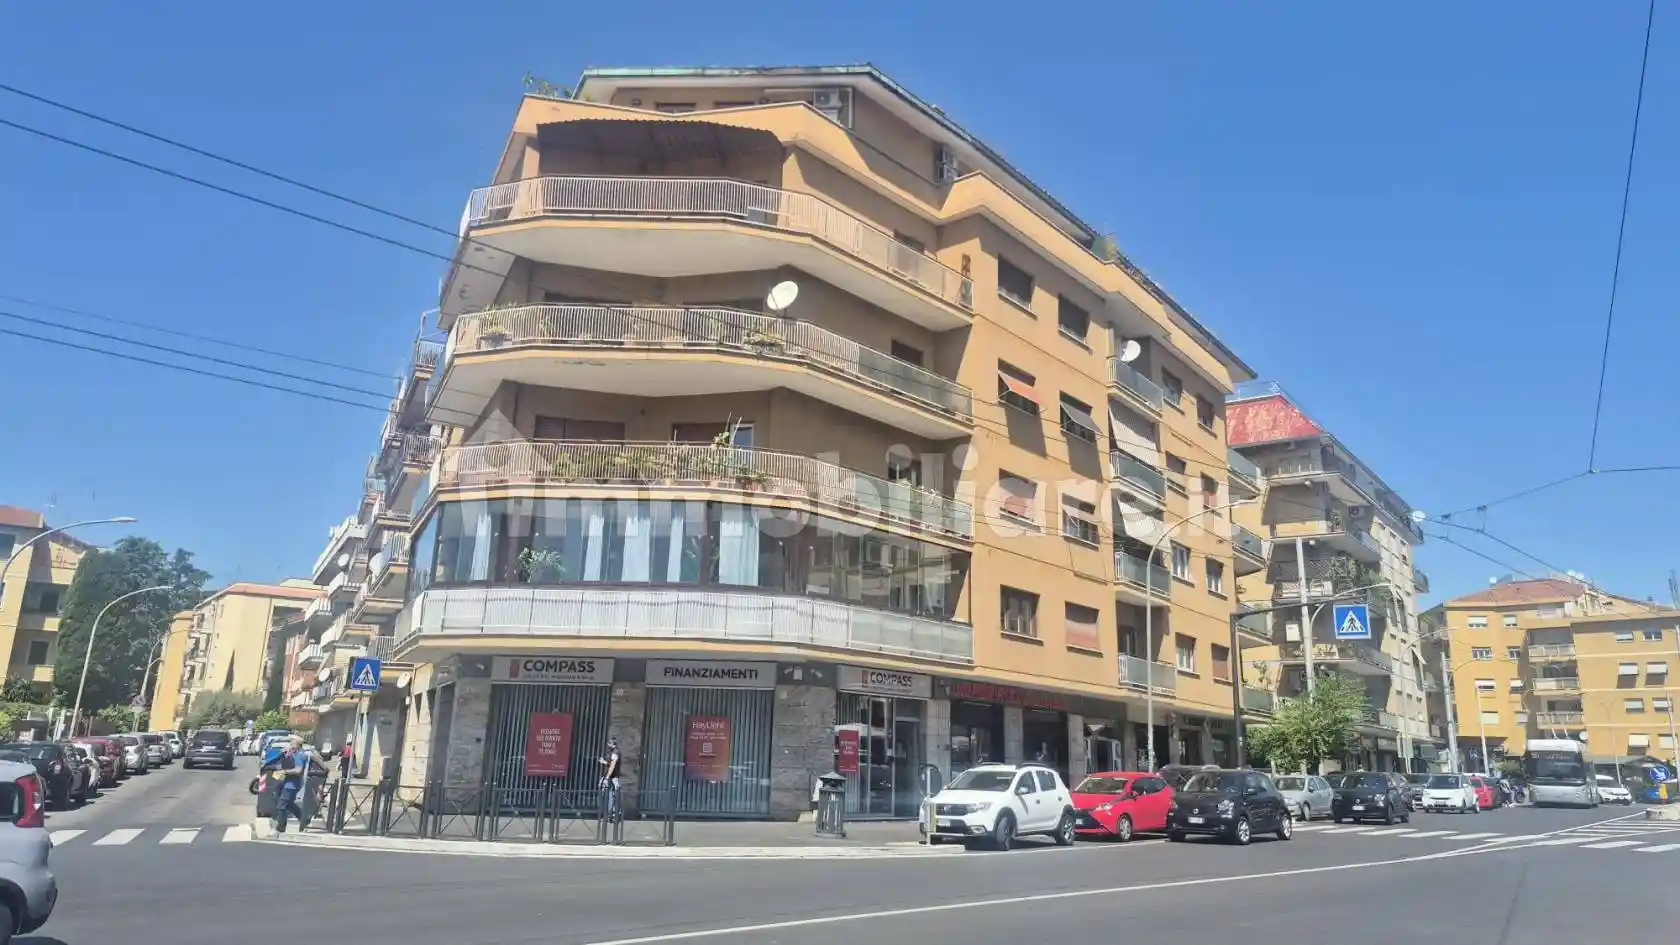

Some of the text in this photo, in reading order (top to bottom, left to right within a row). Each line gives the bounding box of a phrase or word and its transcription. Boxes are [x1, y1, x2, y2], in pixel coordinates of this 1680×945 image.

[523, 660, 596, 674] COMPASS
[663, 666, 759, 680] FINANZIAMENTI
[870, 671, 913, 688] COMPASS
